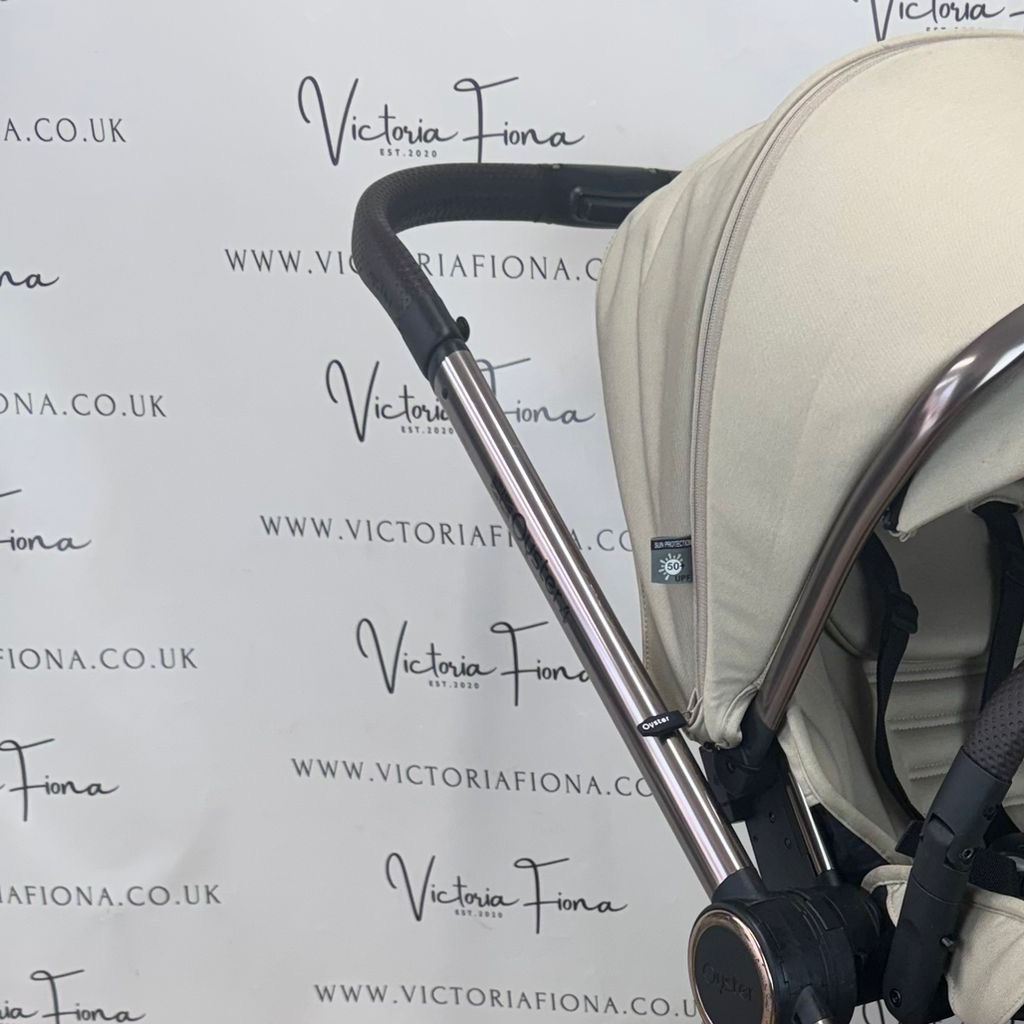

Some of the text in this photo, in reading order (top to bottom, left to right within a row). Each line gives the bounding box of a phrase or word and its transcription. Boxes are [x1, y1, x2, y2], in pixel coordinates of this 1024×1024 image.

[298, 76, 585, 166] Victoria Fiona
[380, 149, 438, 158] EST.2020
[356, 618, 497, 694] Victoria
[642, 716, 669, 730] Oyster
[0, 737, 119, 822] Fiona
[386, 853, 628, 934] Victoria Fiona
